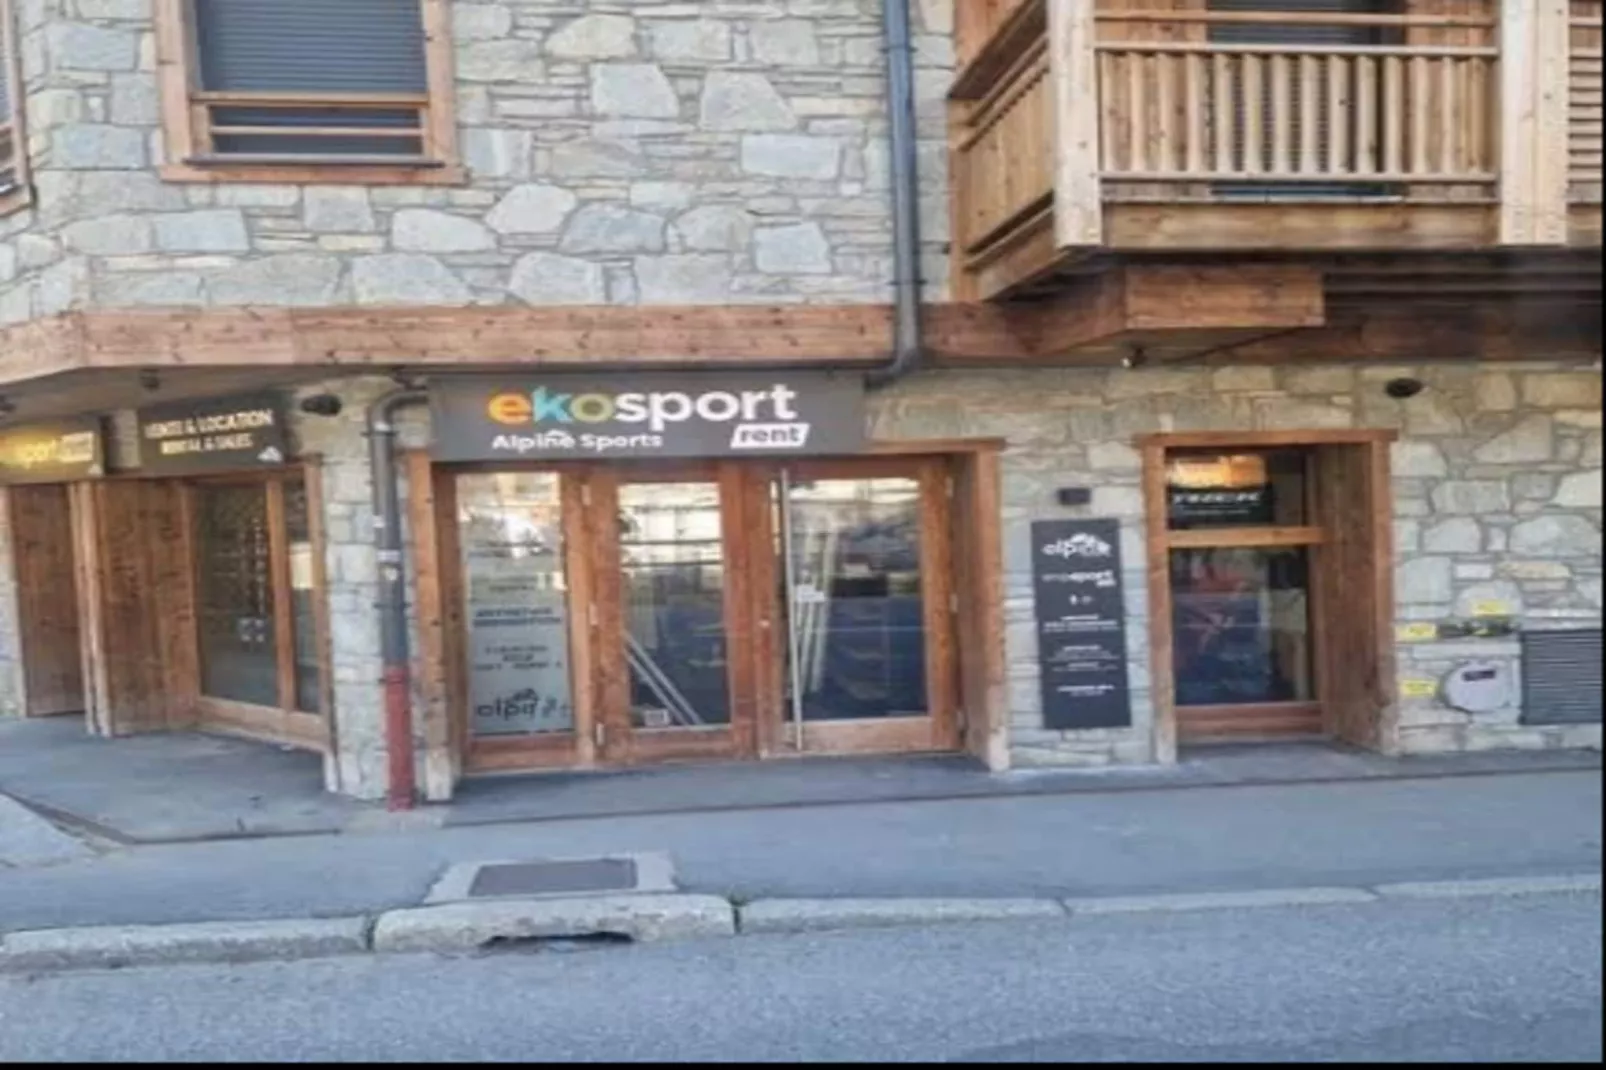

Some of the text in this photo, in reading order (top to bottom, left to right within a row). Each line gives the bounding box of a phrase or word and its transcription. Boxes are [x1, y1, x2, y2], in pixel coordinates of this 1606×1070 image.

[487, 384, 797, 430] ekosport
[491, 430, 663, 453] Alpine Sports
[739, 424, 802, 443] rent
